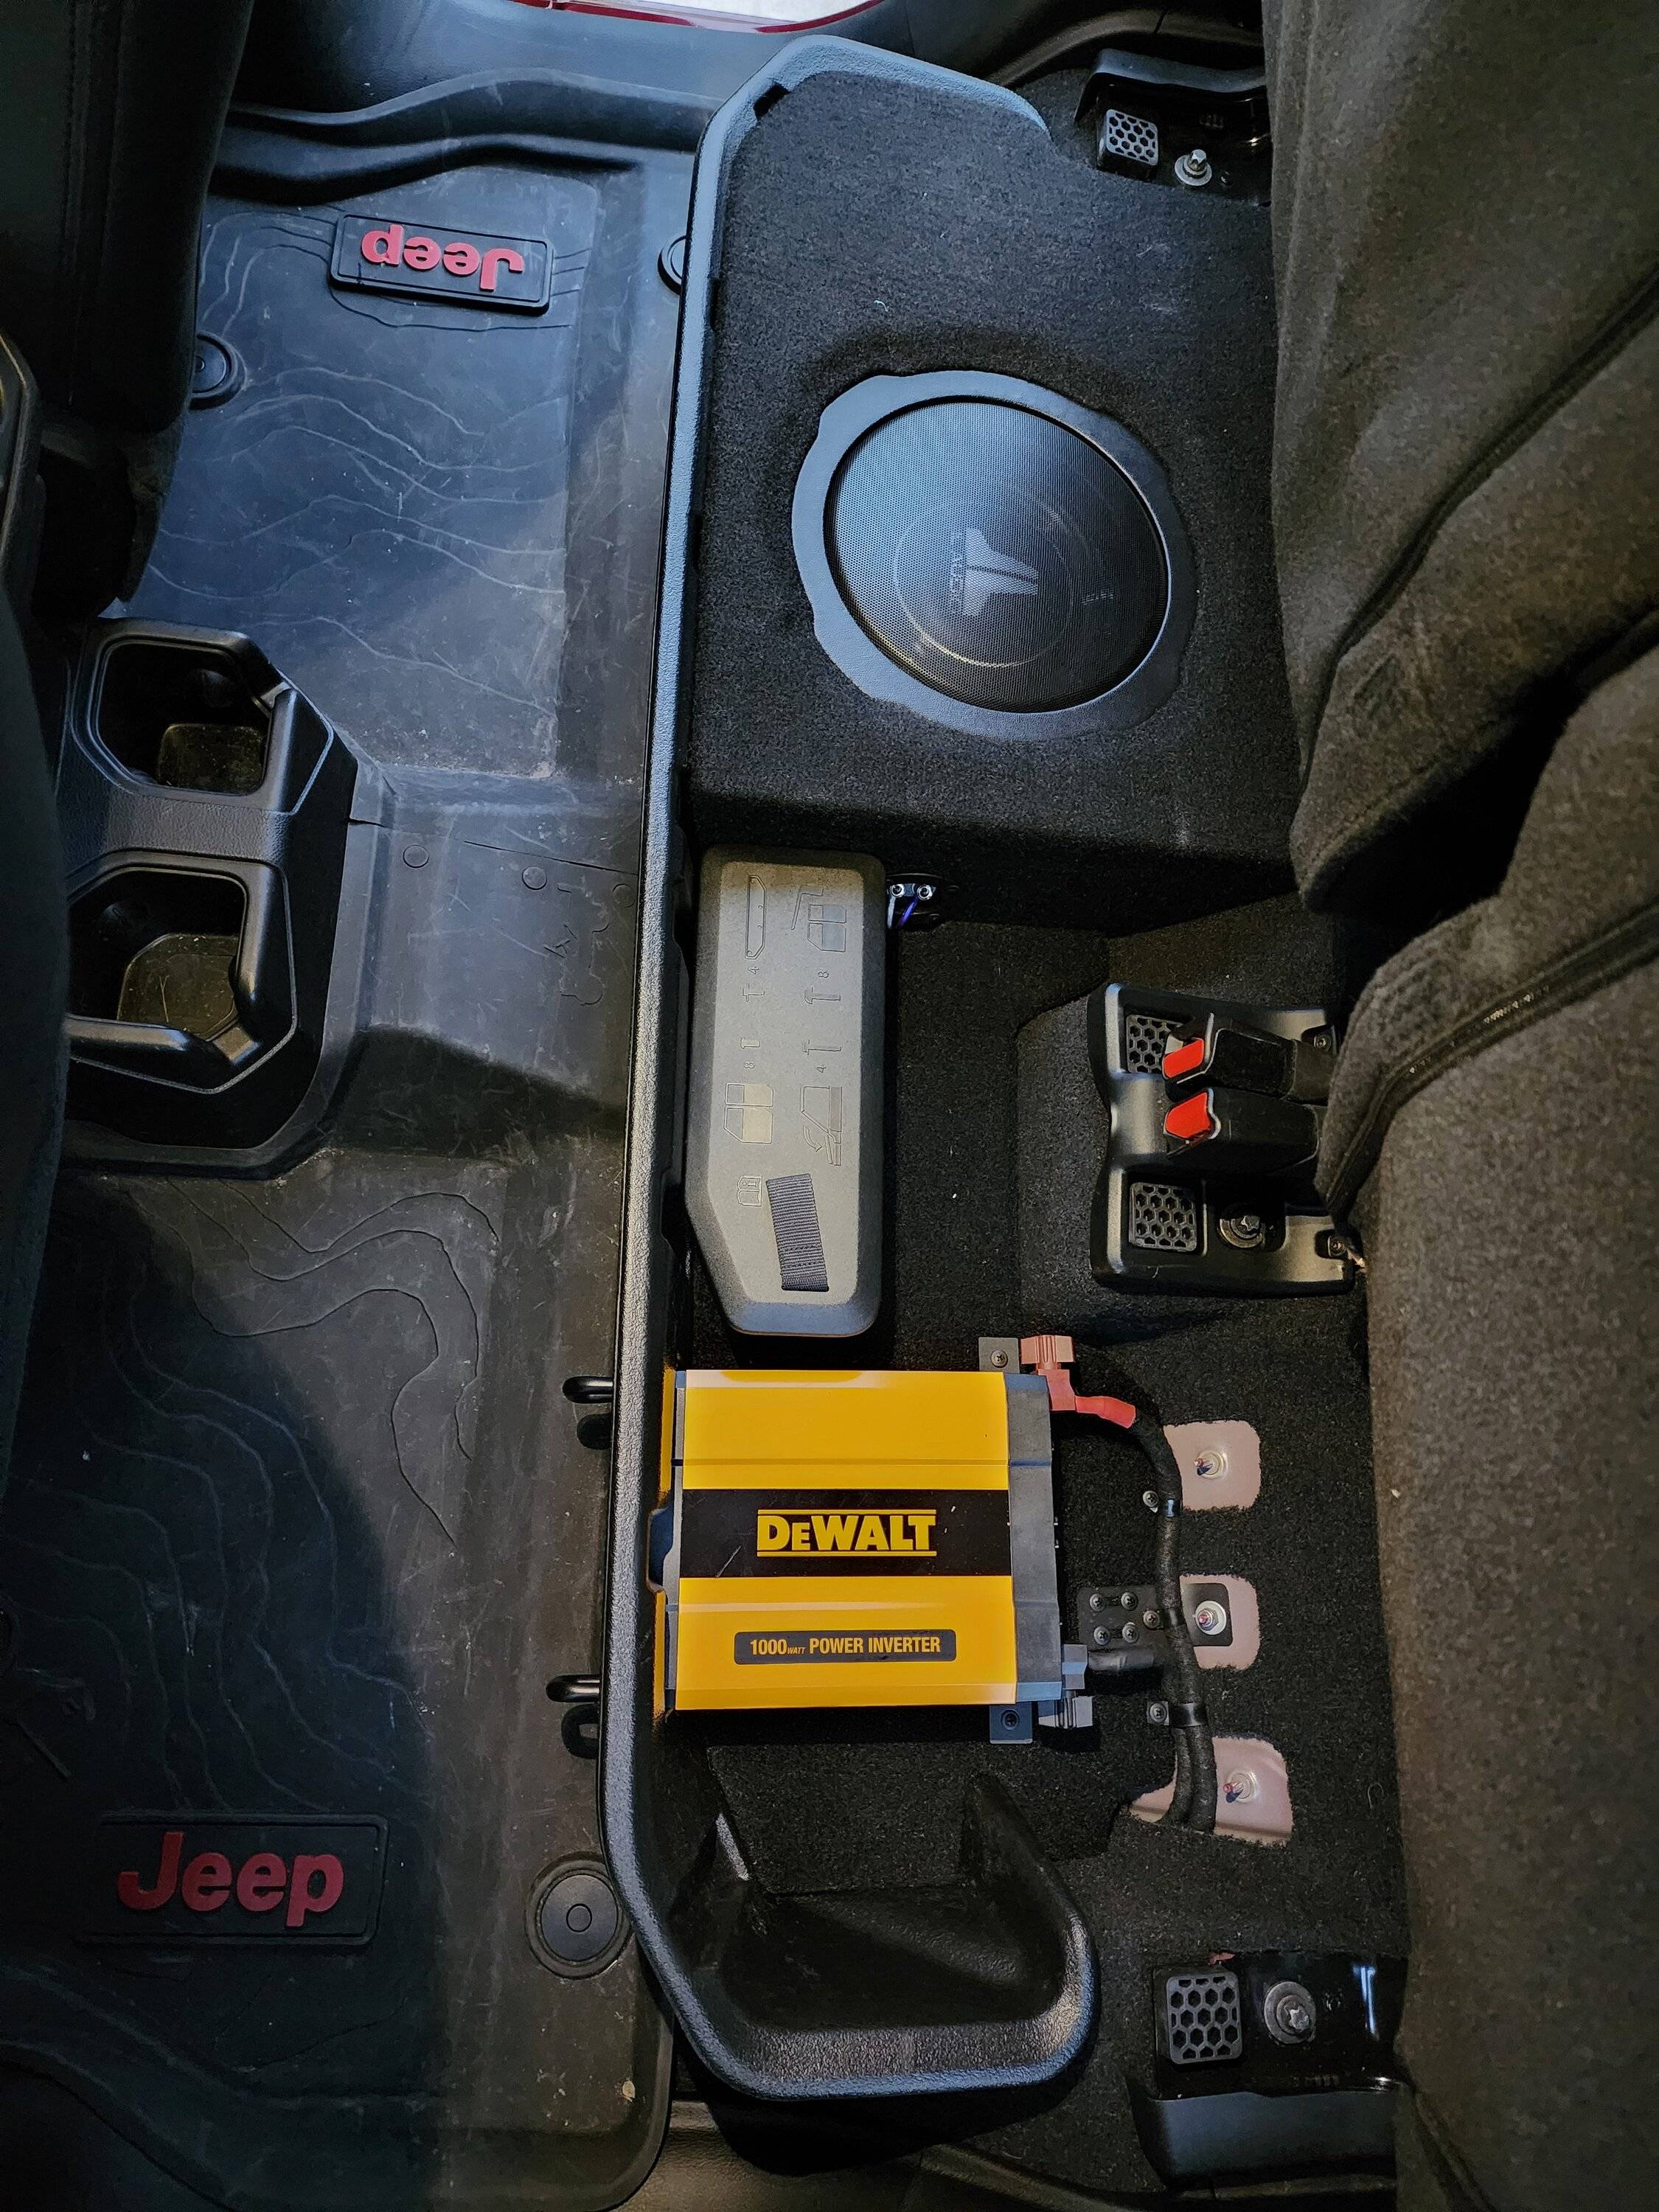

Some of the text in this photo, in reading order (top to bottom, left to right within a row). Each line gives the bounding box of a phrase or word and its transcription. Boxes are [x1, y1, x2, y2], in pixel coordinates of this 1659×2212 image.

[361, 223, 525, 292] Jeep
[747, 965, 760, 975] 4
[815, 1065, 827, 1074] 4
[810, 1637, 863, 1654] POWER
[868, 1636, 941, 1653] INVERTER
[117, 1832, 344, 1927] Jeep
